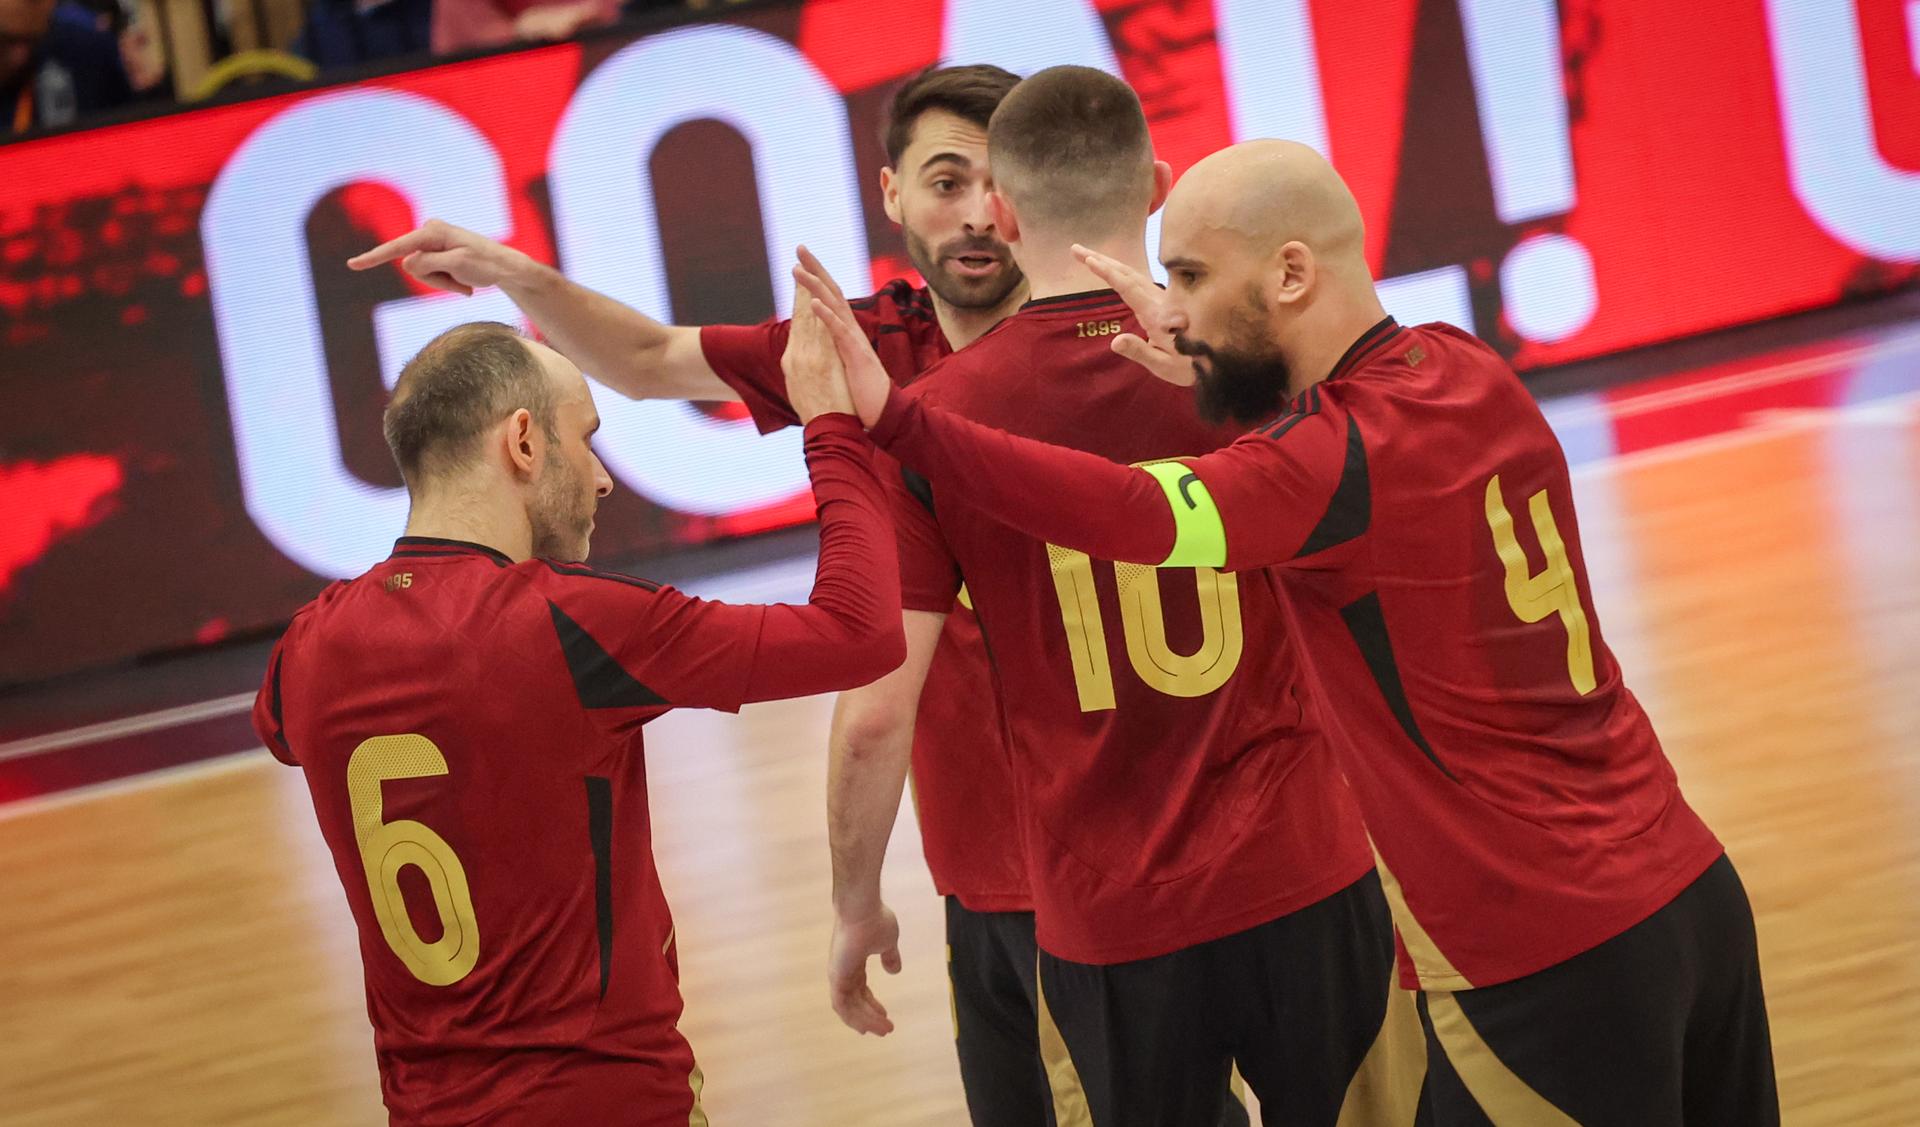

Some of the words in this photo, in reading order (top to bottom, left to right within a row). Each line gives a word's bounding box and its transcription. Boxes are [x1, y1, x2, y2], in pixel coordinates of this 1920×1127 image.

[200, 0, 1598, 581] GO!
[1077, 320, 1121, 338] 1895
[1045, 457, 1244, 711] 10
[1486, 474, 1597, 696] 4
[347, 733, 480, 986] 6
